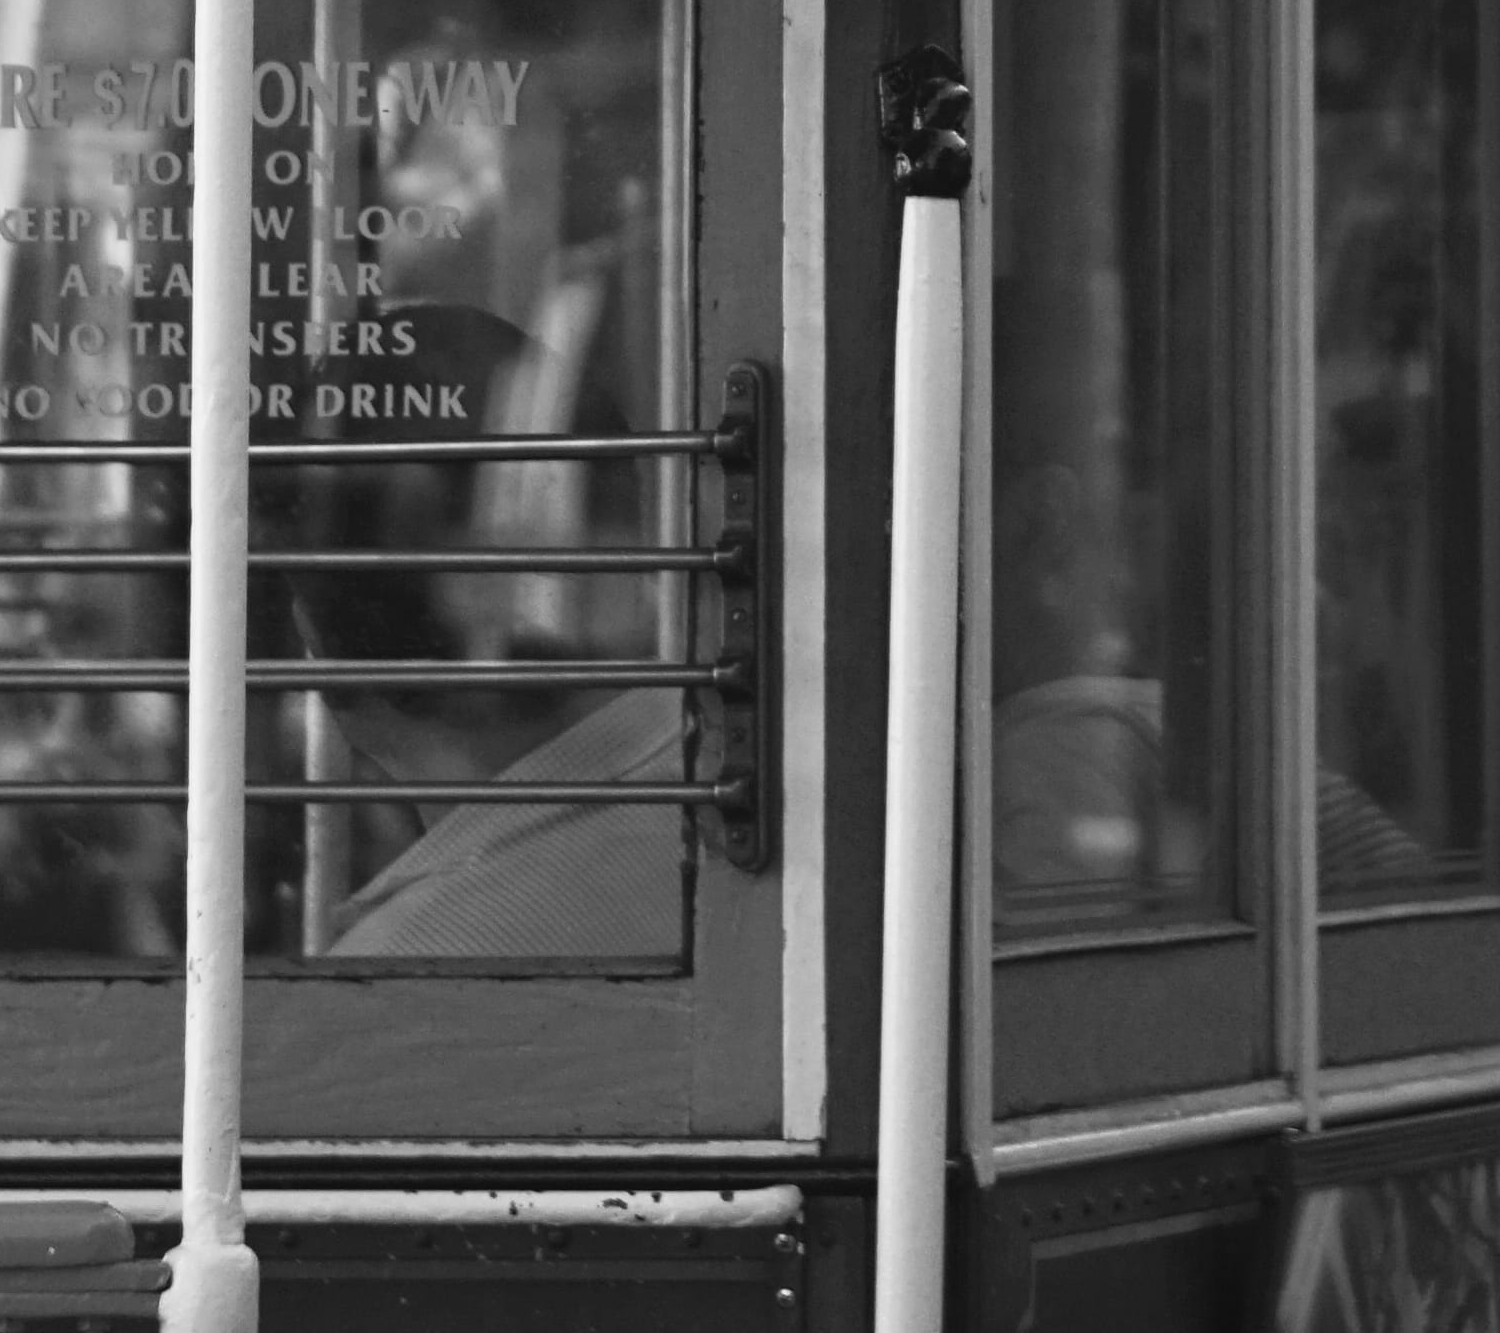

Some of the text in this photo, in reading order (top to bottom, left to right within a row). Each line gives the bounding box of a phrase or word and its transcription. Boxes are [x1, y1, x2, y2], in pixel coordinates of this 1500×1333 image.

[94, 57, 194, 131] $7.0
[252, 61, 373, 128] ONE
[399, 60, 529, 126] WAY
[112, 150, 334, 185] HO ON
[102, 206, 294, 241] YELW
[60, 262, 382, 298] AREA LEAR
[31, 322, 105, 357] NO
[316, 383, 468, 419] DRINK
